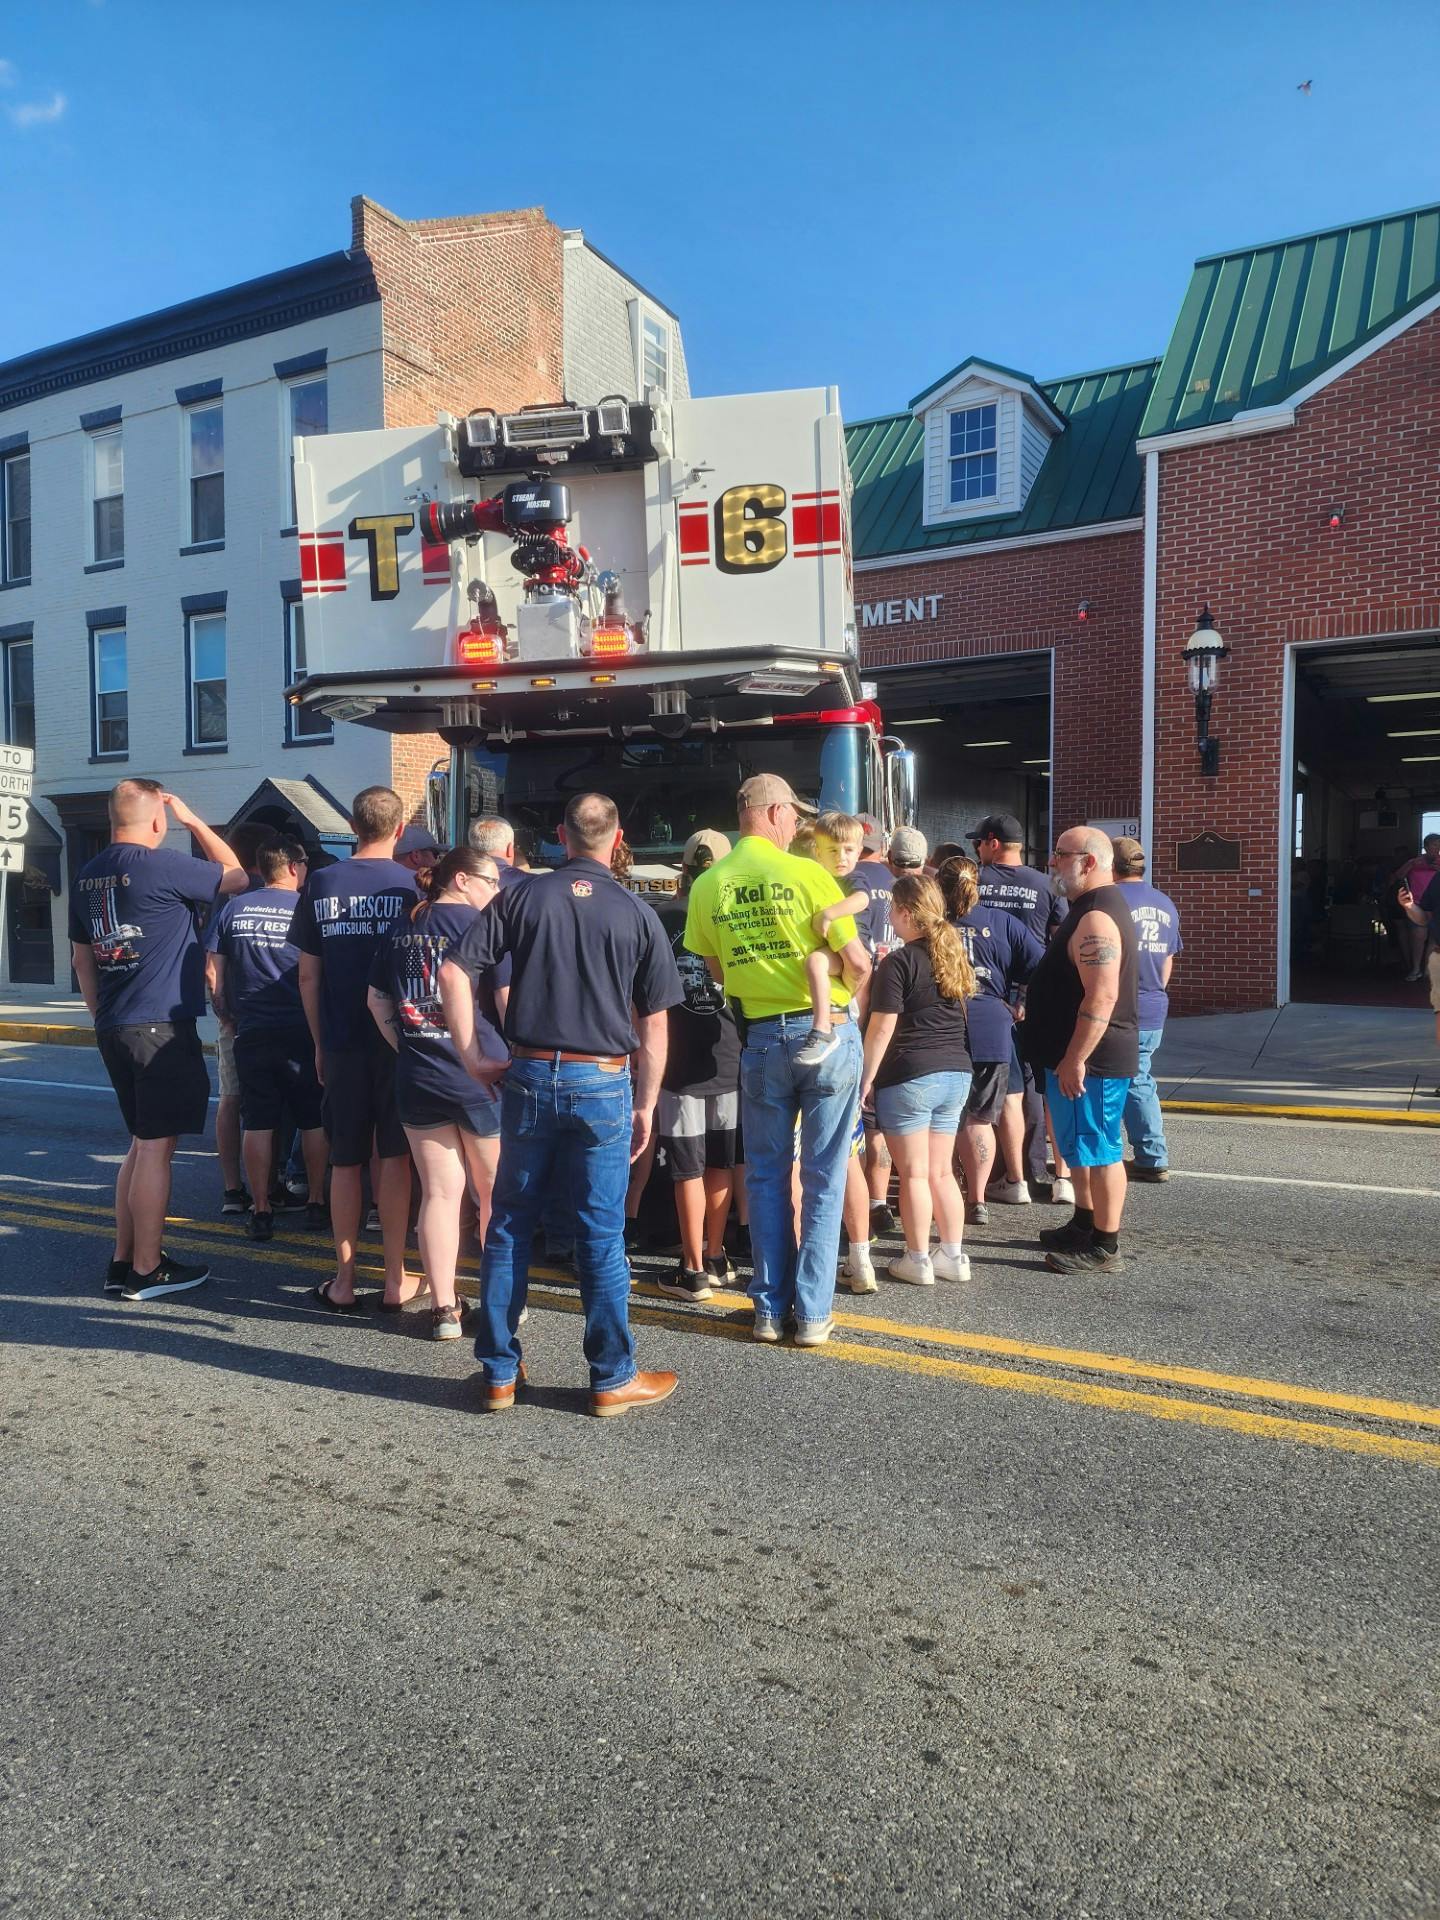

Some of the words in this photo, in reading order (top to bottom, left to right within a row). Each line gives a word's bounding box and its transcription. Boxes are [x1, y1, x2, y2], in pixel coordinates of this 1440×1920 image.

[512, 494, 535, 502] STREAM
[527, 500, 550, 508] MASTER
[348, 513, 414, 601] T
[714, 485, 787, 574] 6
[3, 750, 21, 764] TO
[1, 775, 29, 791] ORTH
[1122, 824, 1137, 836] 19
[79, 876, 117, 891] TOWER
[122, 873, 130, 886] 6
[623, 879, 680, 893] ITSB
[735, 884, 765, 904] Kel
[771, 883, 794, 901] Co
[1000, 885, 1038, 902] RESCUE
[314, 896, 339, 923] FIRE
[752, 907, 758, 917] &
[729, 920, 761, 932] Service
[959, 927, 976, 937] ER
[982, 927, 991, 938] 6
[1142, 919, 1160, 941] 72
